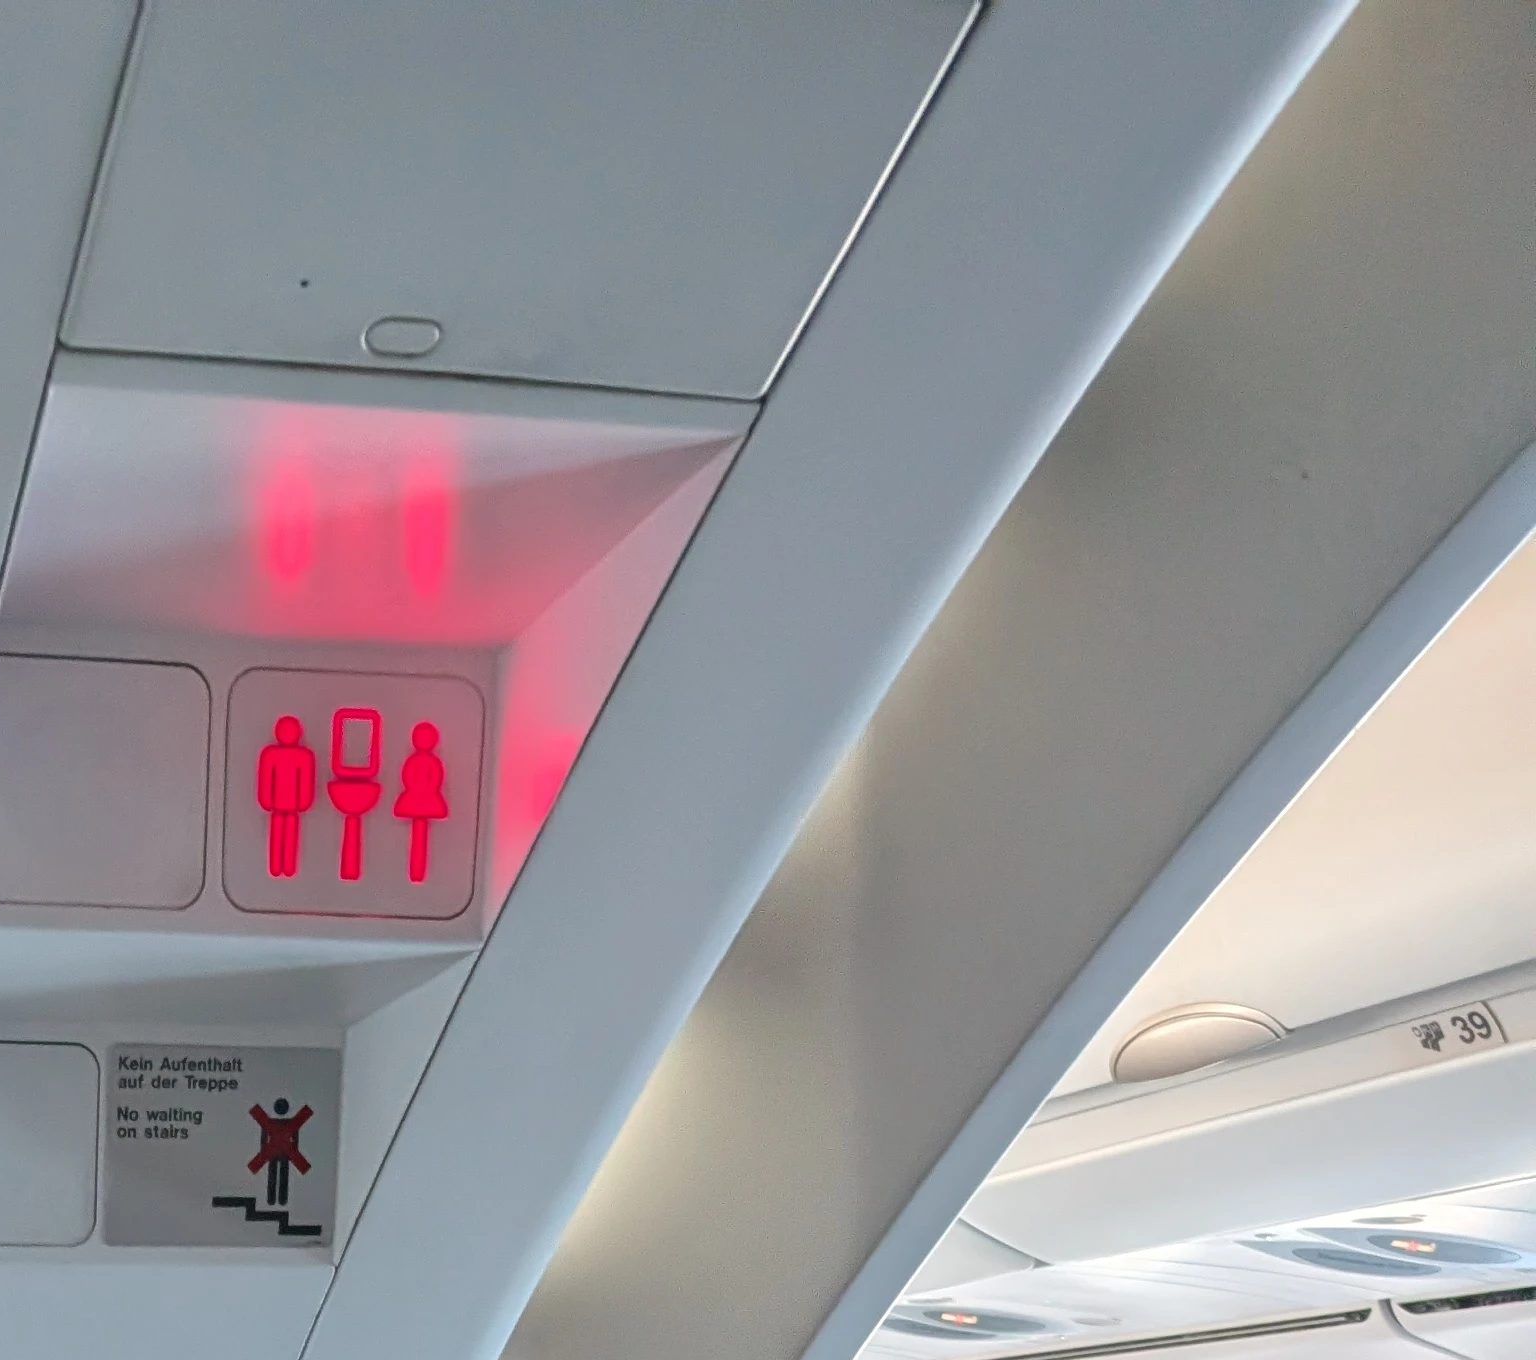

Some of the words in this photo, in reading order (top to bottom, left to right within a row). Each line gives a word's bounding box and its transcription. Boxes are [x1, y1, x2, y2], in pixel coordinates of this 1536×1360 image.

[1450, 1011, 1492, 1044] 39
[118, 1056, 153, 1072] Kein
[160, 1057, 243, 1073] Aufenthalt
[118, 1074, 145, 1089] auf
[151, 1075, 178, 1090] der
[184, 1075, 239, 1092] Treppe
[117, 1106, 139, 1122] No
[146, 1108, 203, 1125] waiting
[117, 1126, 137, 1139] on
[144, 1125, 189, 1139] stairs
